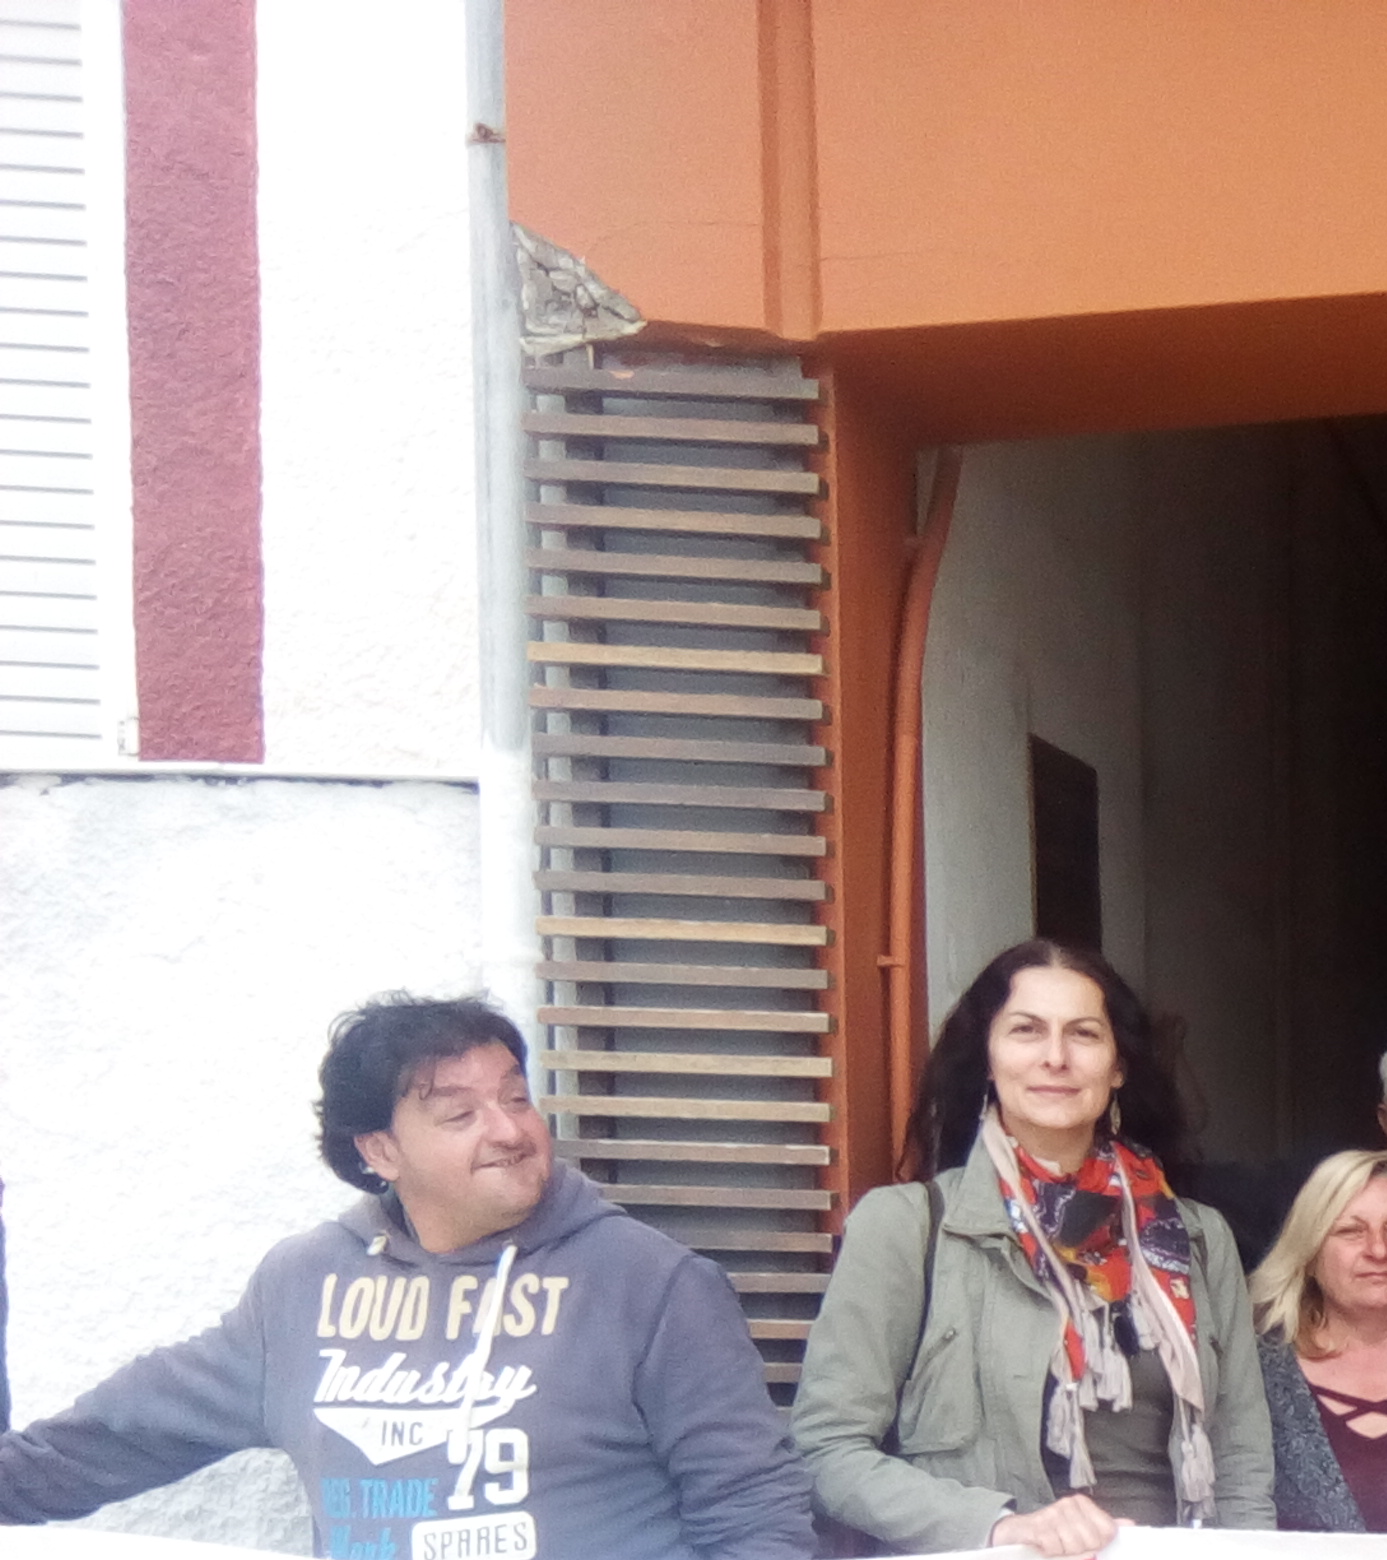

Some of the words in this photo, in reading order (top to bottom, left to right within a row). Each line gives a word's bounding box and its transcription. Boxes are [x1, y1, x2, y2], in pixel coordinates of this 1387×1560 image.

[316, 1273, 431, 1341] LOUD
[445, 1272, 570, 1340] FAST
[380, 1419, 425, 1447] INC
[446, 1427, 530, 1511] 79
[359, 1477, 440, 1519] TRADE
